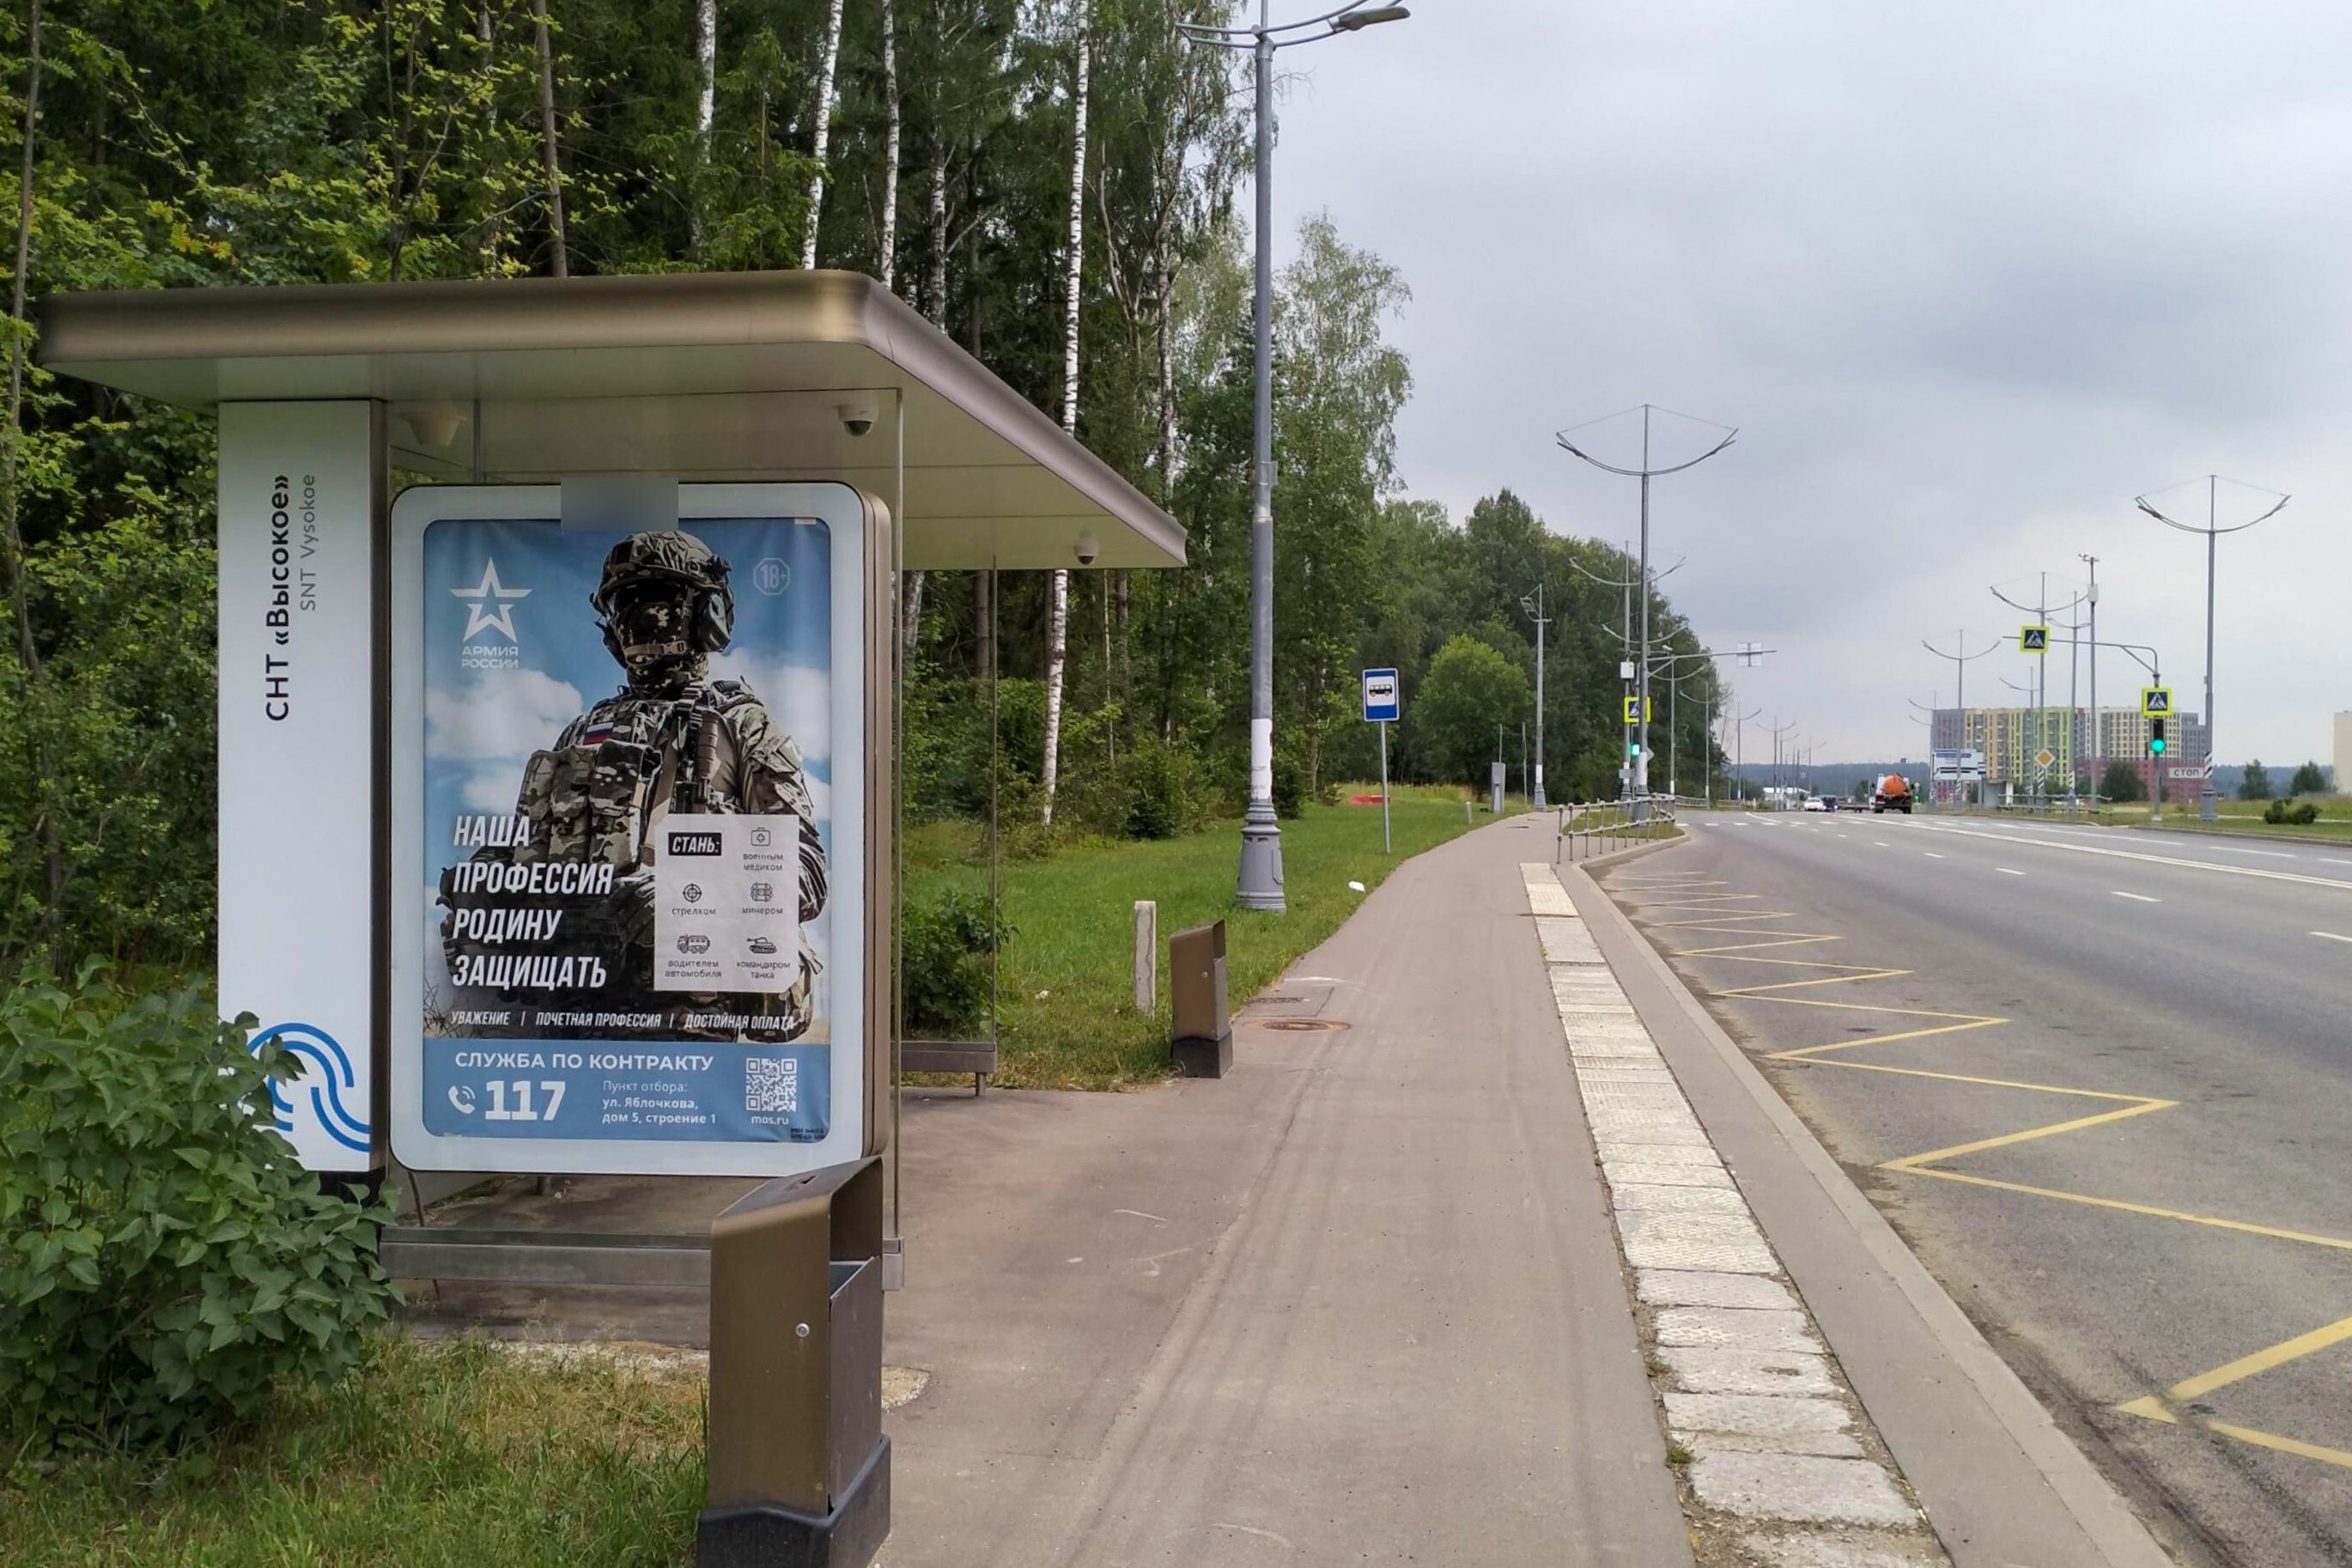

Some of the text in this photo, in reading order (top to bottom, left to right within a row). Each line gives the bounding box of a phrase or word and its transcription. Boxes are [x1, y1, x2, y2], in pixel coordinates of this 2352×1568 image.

[299, 474, 319, 611] SNT Vysokoe
[760, 564, 787, 589] 18+
[265, 475, 289, 721] СНТ «Высокое»
[461, 646, 519, 657] АРМИЯ
[461, 658, 519, 669] РОССИИ
[453, 815, 530, 848] НАША
[672, 836, 720, 854] СТАНЬ:
[743, 862, 783, 872] медиком
[453, 861, 615, 895] ПРОФЕССИЯ
[672, 907, 716, 916] стрелком
[742, 907, 783, 915] минером
[453, 908, 563, 944] РОДИНУ
[668, 959, 719, 968] водителем
[736, 960, 791, 970] командиром
[453, 954, 607, 991] ЗАЩИЩАТЬ
[665, 969, 722, 978] автомобиля
[451, 1011, 511, 1026] УВАЖЕНИЕ
[536, 1012, 662, 1028] ПОЧЕТНАЯ ПРОФЕССИЯ
[684, 1012, 795, 1030] ДОСТОЙНАЯ ОПЛАТА
[455, 1052, 714, 1071] СЛУЖБА ПО КОНТРАКТУ
[603, 1080, 688, 1094] Пункт отбора:
[485, 1080, 566, 1121] 117
[602, 1098, 698, 1110] ул. Яблочкова,
[602, 1113, 716, 1126] дом 5, строение 1
[751, 1116, 789, 1125] mos.ru
